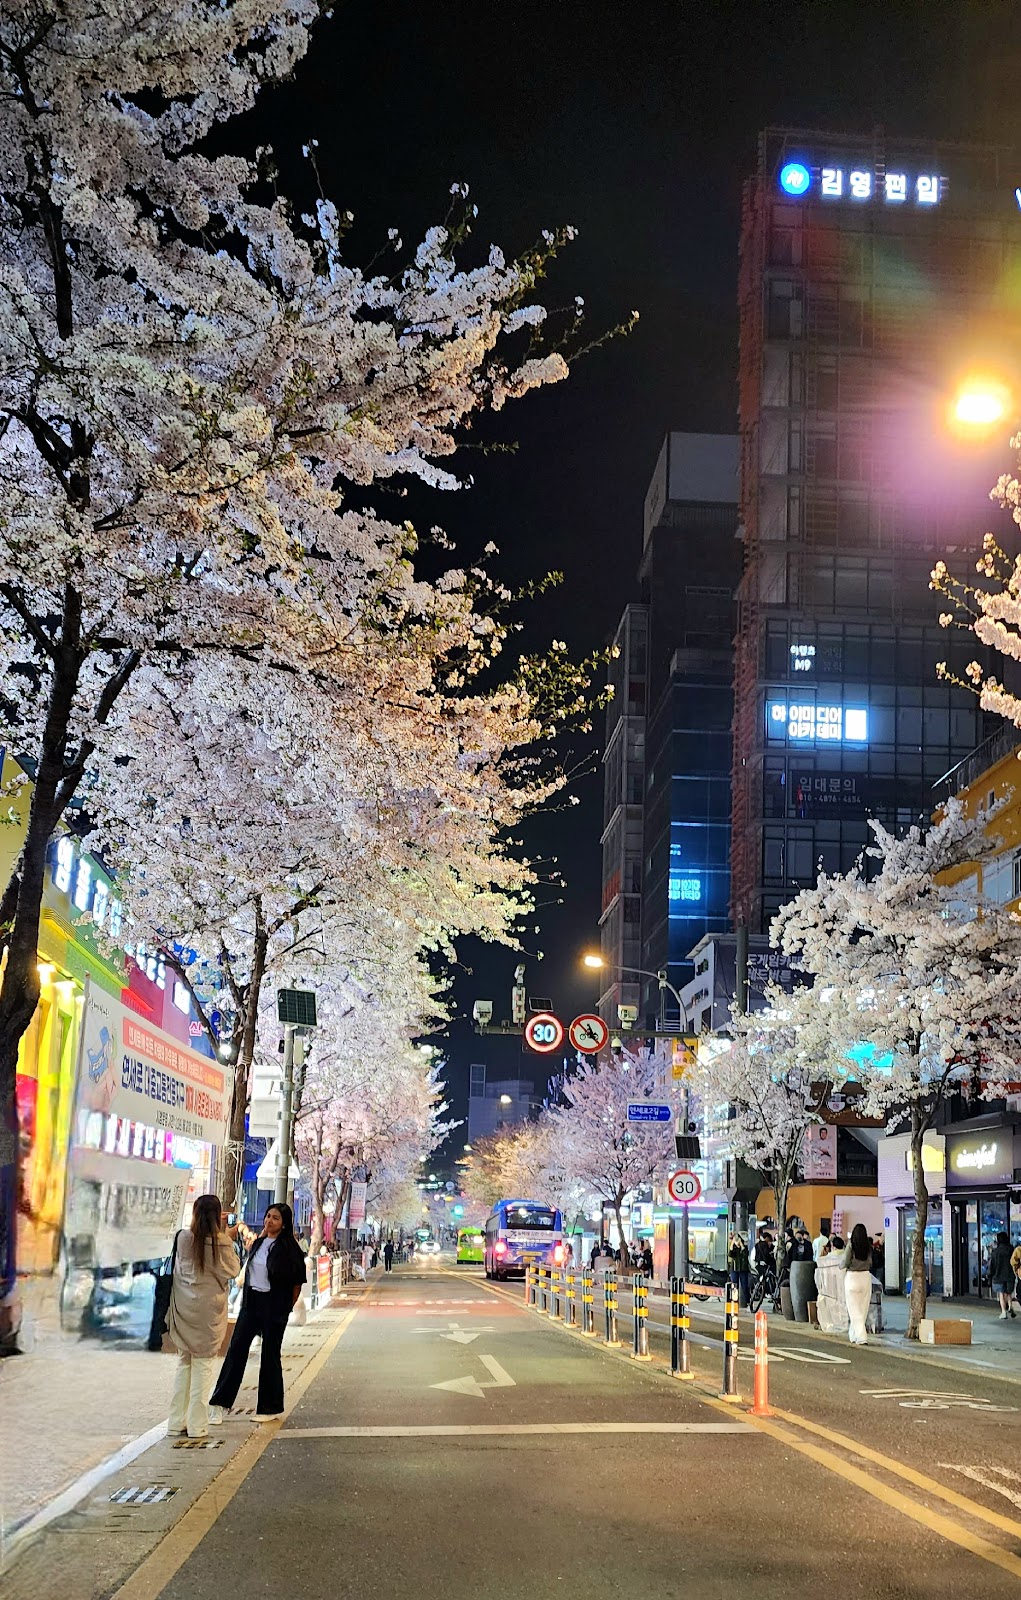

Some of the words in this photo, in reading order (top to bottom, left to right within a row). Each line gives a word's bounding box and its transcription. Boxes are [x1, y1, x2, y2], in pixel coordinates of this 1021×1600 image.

[821, 168, 938, 203] 김영편입
[795, 659, 811, 671] M9
[771, 704, 843, 723] 하이미디어
[788, 721, 843, 740] 아카데미
[799, 776, 856, 794] 임대문의
[533, 1024, 556, 1043] 30
[121, 1054, 143, 1093] 연세로
[675, 1180, 694, 1195] 30
